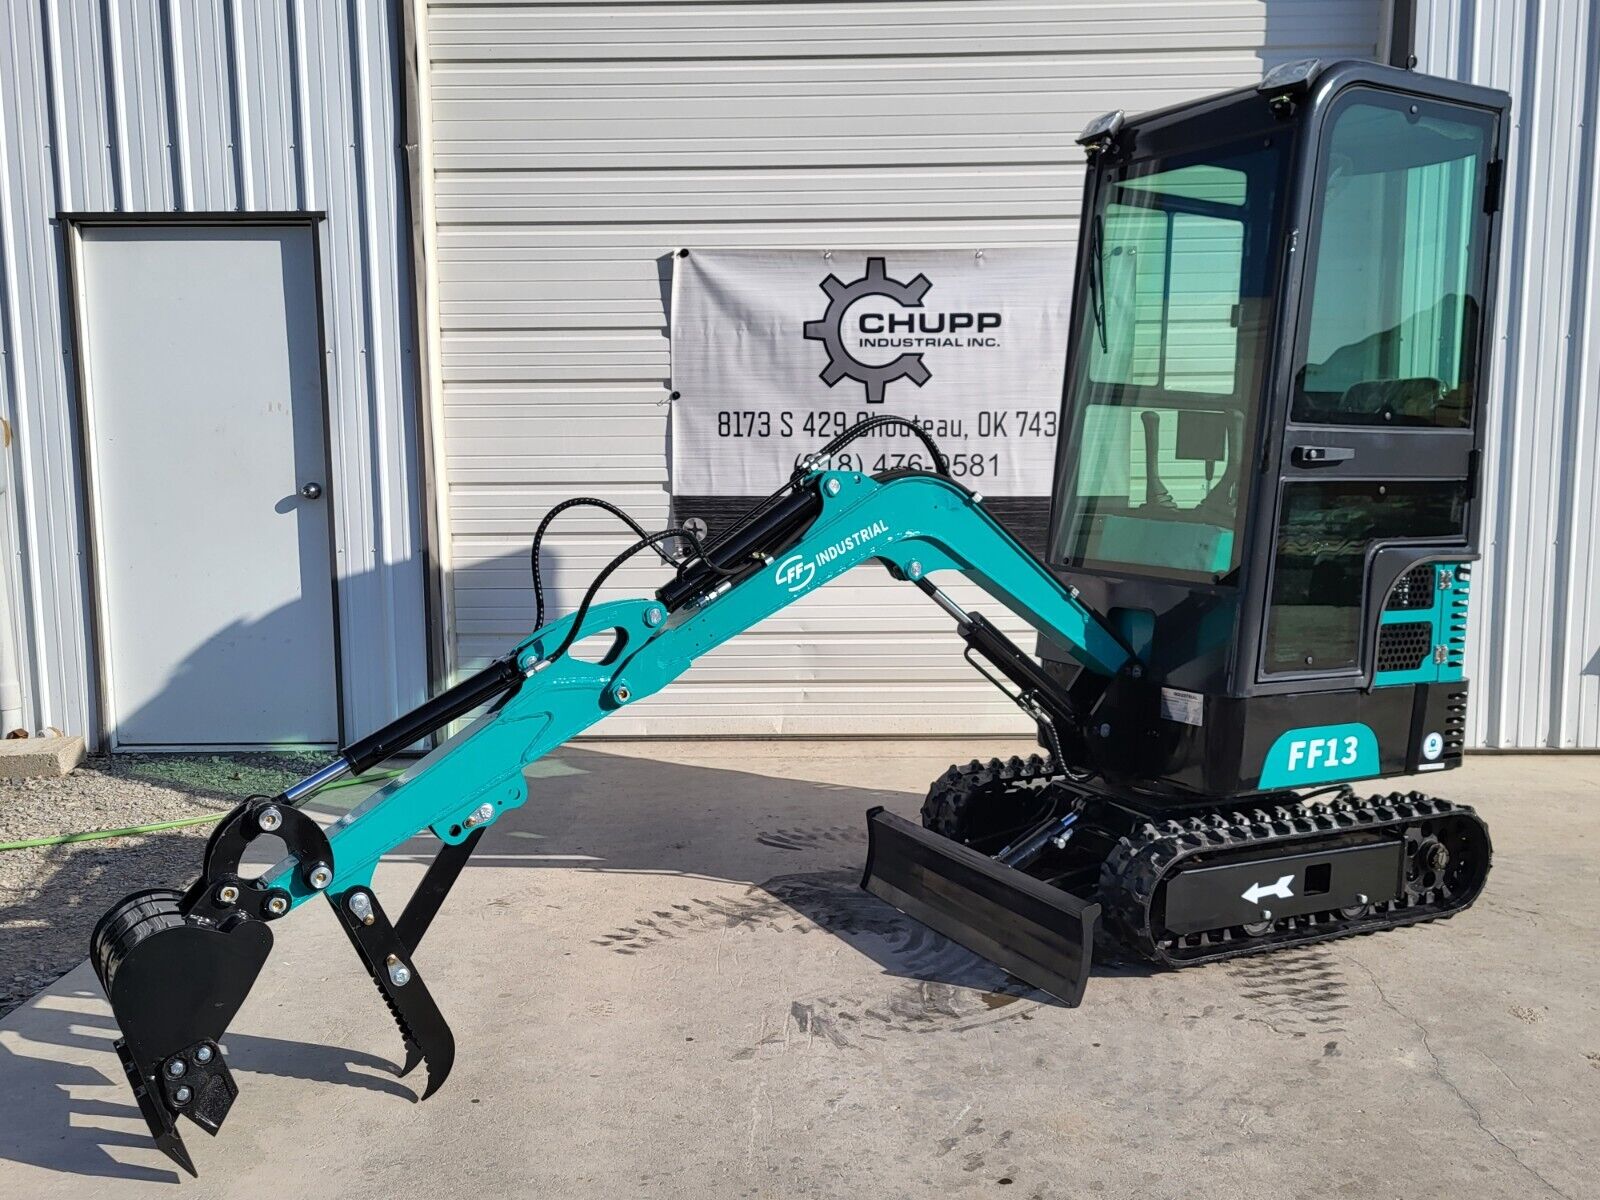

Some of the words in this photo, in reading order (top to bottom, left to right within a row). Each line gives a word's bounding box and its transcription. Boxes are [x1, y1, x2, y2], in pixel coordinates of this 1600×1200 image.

[859, 313, 1001, 333] CHUPP
[859, 338, 963, 348] INDUSTRIAL
[967, 338, 1000, 347] INC.
[718, 411, 771, 437] 8173
[780, 411, 793, 437] S
[802, 411, 846, 437] 429
[978, 411, 1007, 437] OK
[815, 520, 889, 566] INDUSTRIAL
[1288, 736, 1358, 771] FF13
